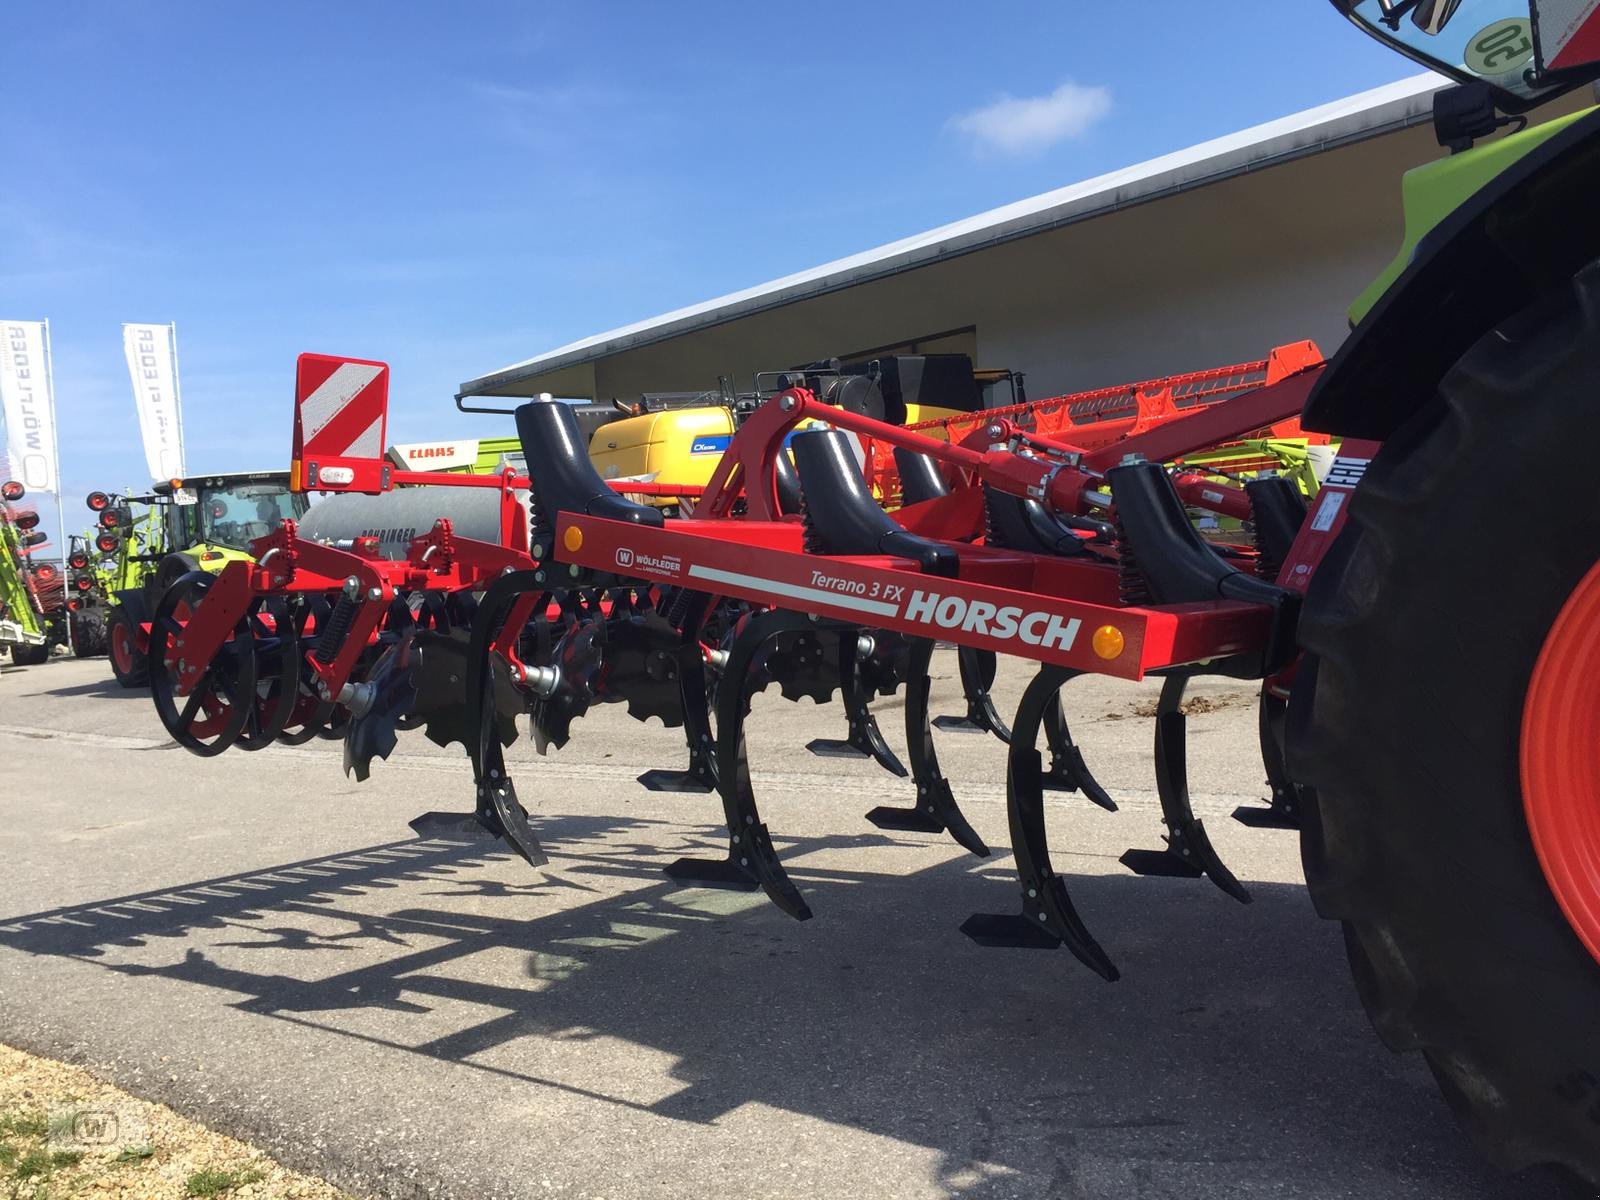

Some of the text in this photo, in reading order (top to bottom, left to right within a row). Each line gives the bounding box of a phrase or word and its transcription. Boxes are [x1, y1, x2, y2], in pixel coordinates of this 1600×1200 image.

[409, 447, 455, 459] CLAAS
[636, 554, 681, 572] WÖLFLEDER
[811, 570, 906, 602] Terrano 3 FX
[904, 590, 1081, 651] HORSCH
